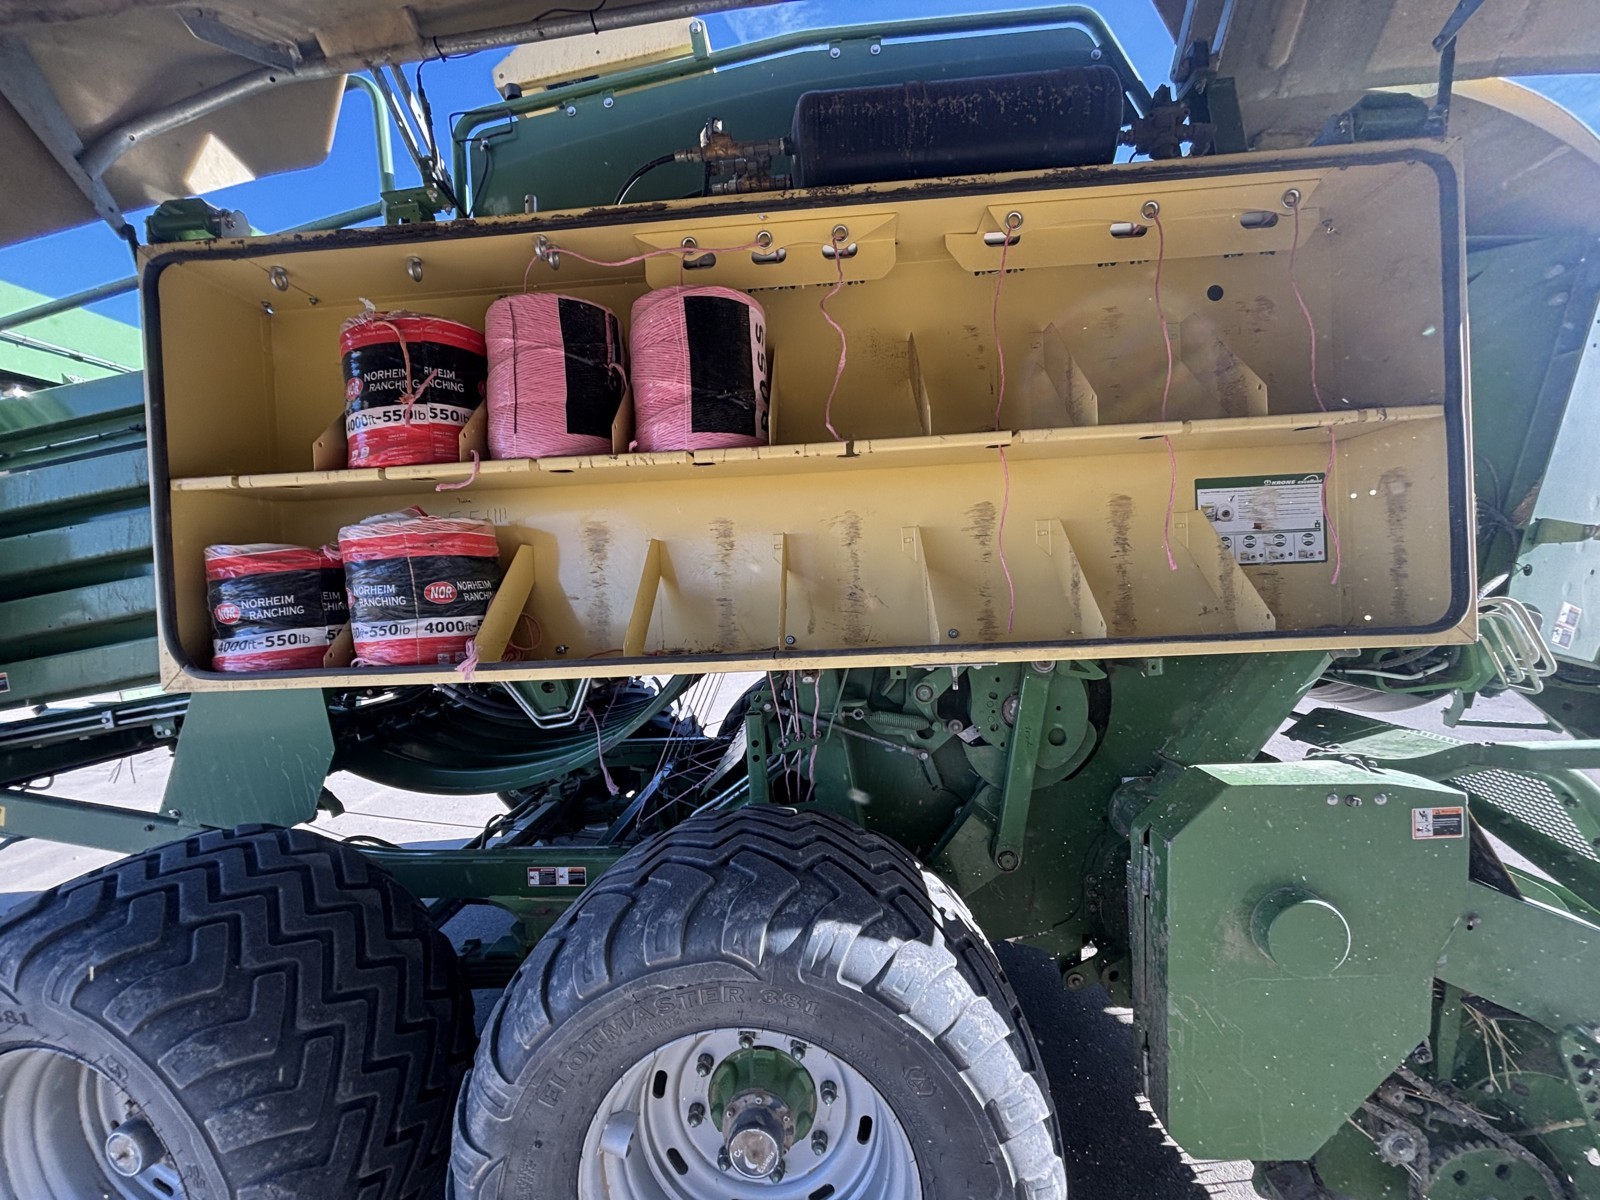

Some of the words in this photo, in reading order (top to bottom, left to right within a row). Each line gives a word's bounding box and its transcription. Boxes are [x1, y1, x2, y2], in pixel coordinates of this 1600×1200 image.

[369, 379, 422, 392] RANCHIG
[353, 584, 395, 596] NORHEIM
[456, 580, 492, 590] NORHEIM
[430, 586, 453, 599] NOR
[240, 595, 295, 609] NORHEIM
[358, 596, 407, 607] RANCHING
[218, 606, 237, 621] NOR
[249, 605, 305, 620] RANCHING
[0, 1010, 33, 1027] 81
[538, 984, 746, 1108] FLOTMASTER
[760, 988, 821, 1018] 381
